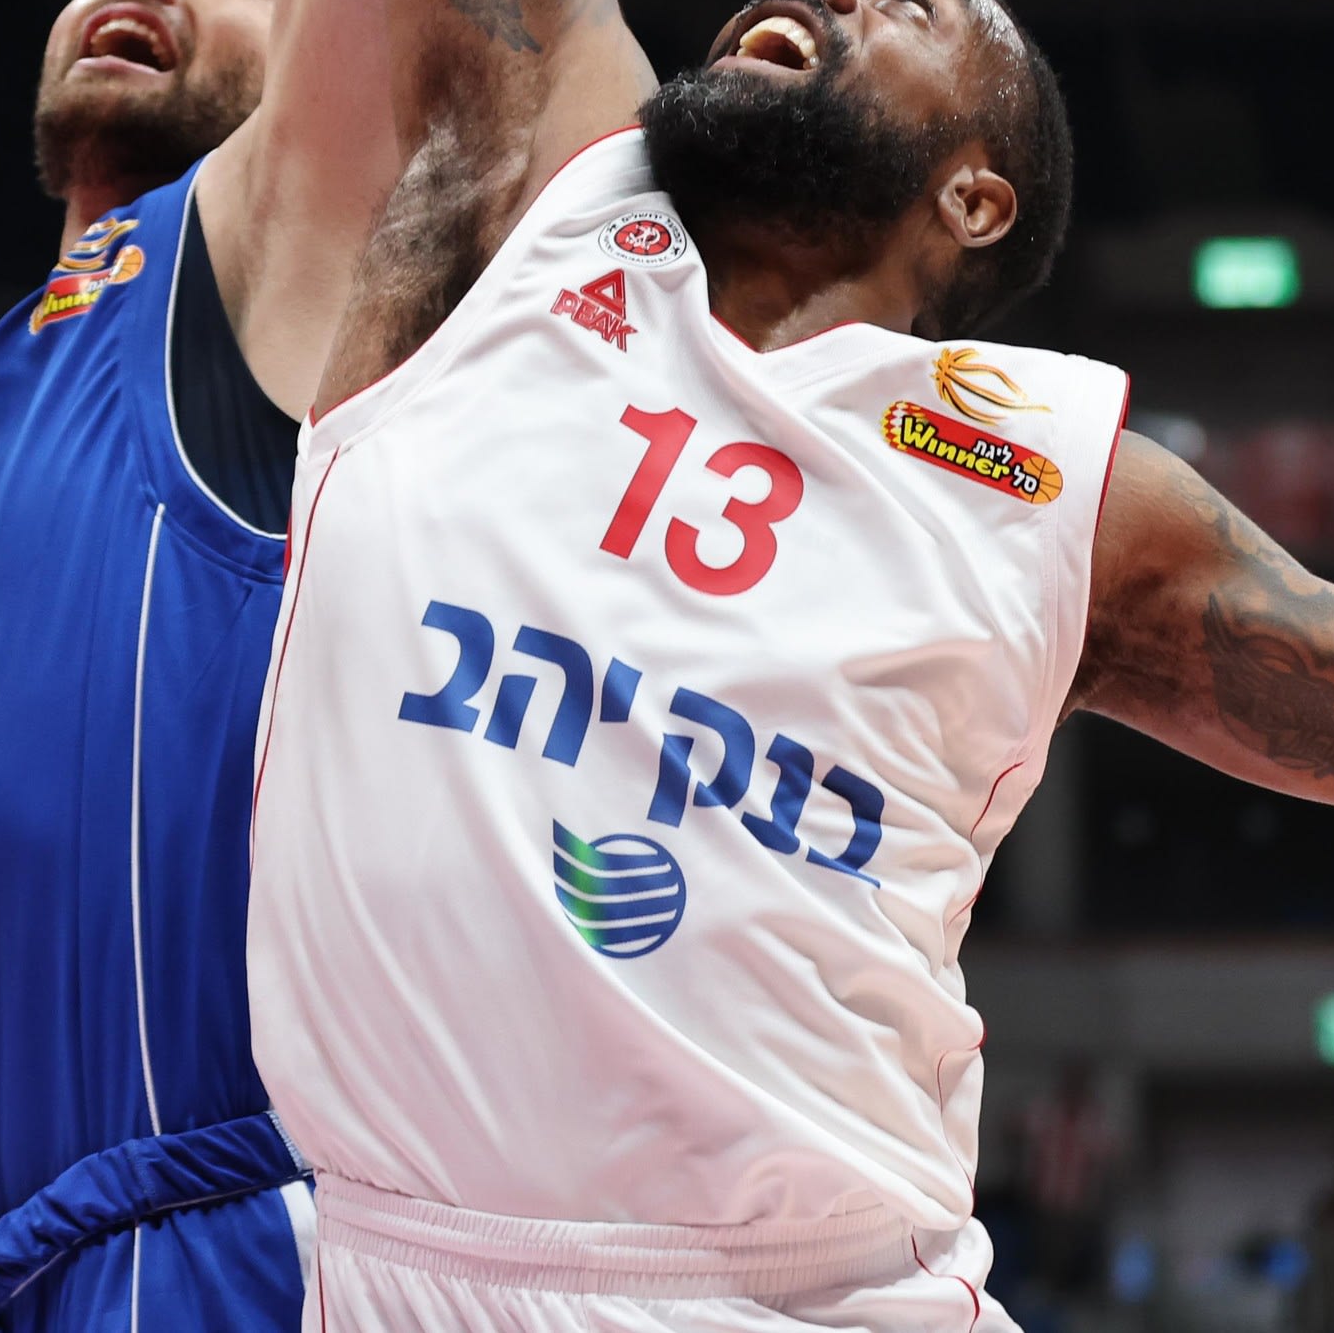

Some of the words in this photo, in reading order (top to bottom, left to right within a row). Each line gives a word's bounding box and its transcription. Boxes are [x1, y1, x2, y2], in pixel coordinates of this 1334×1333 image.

[550, 288, 639, 353] PEAK
[599, 403, 804, 596] 13
[903, 416, 1010, 480] Winner
[972, 439, 1013, 464] ליגת
[397, 599, 643, 768] יהב
[646, 686, 885, 888] בנק
